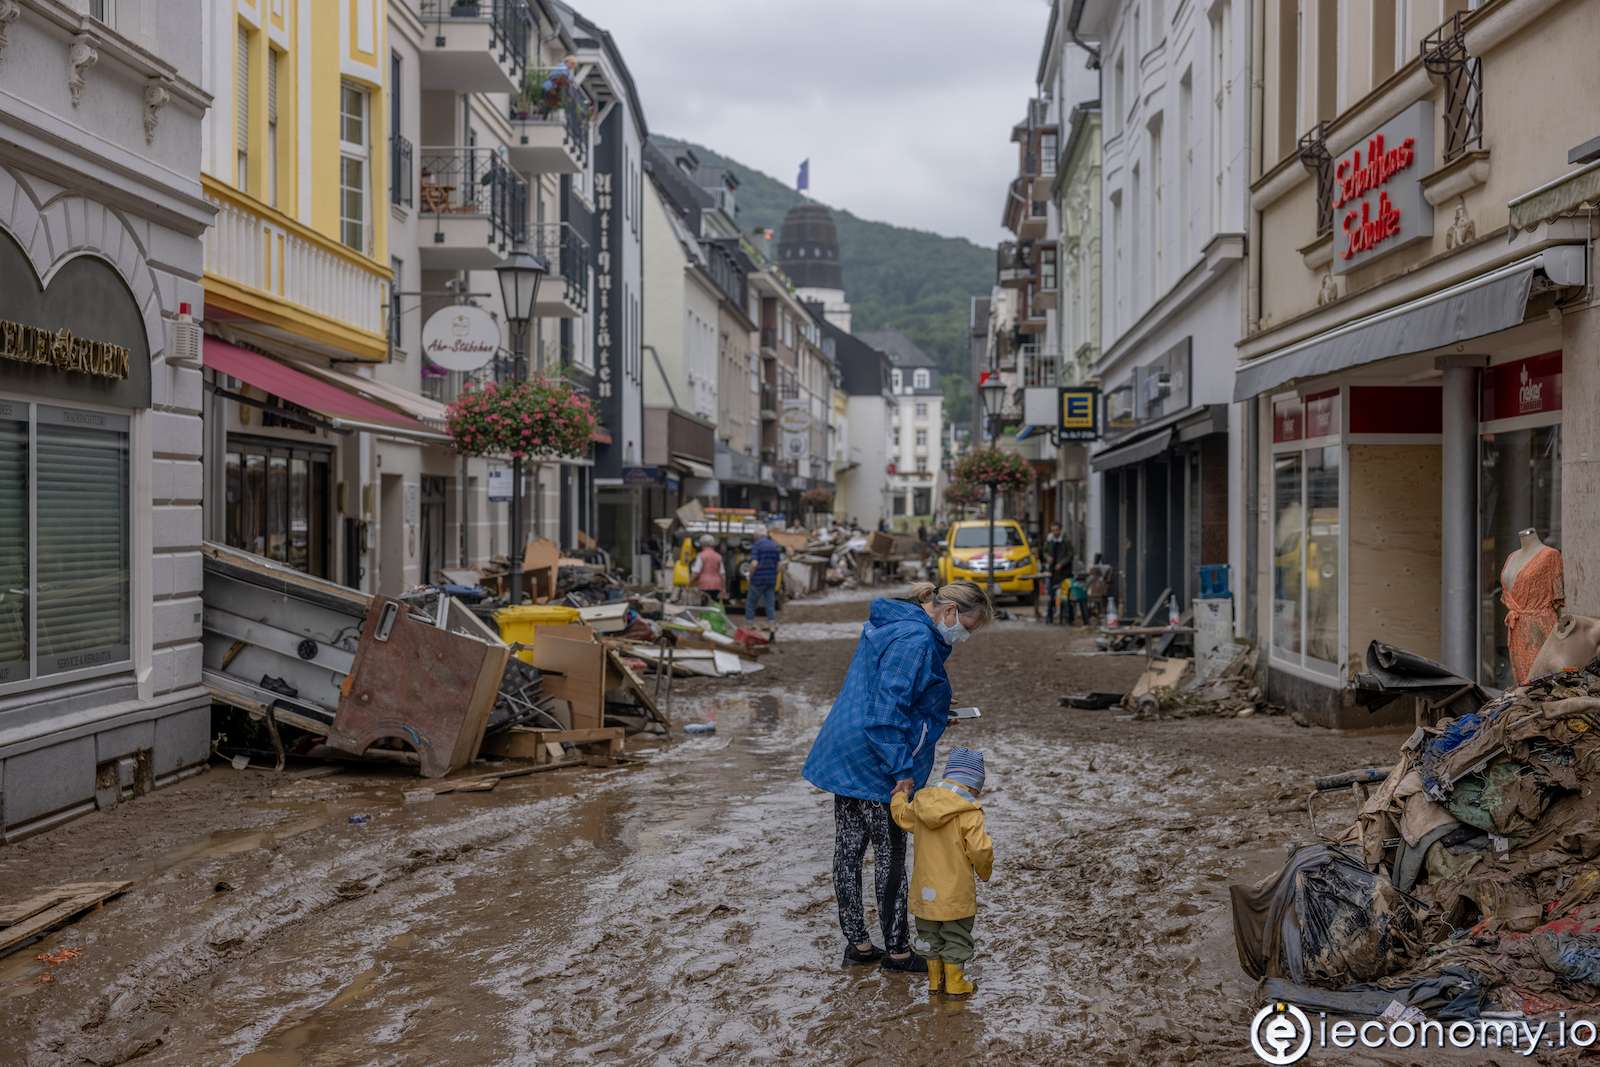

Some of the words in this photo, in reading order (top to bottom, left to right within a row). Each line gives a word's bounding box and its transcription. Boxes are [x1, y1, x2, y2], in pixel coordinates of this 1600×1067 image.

[1332, 134, 1416, 209] Schuhhaus
[1342, 191, 1401, 260] Schulte
[595, 172, 612, 397] Antiquitäten
